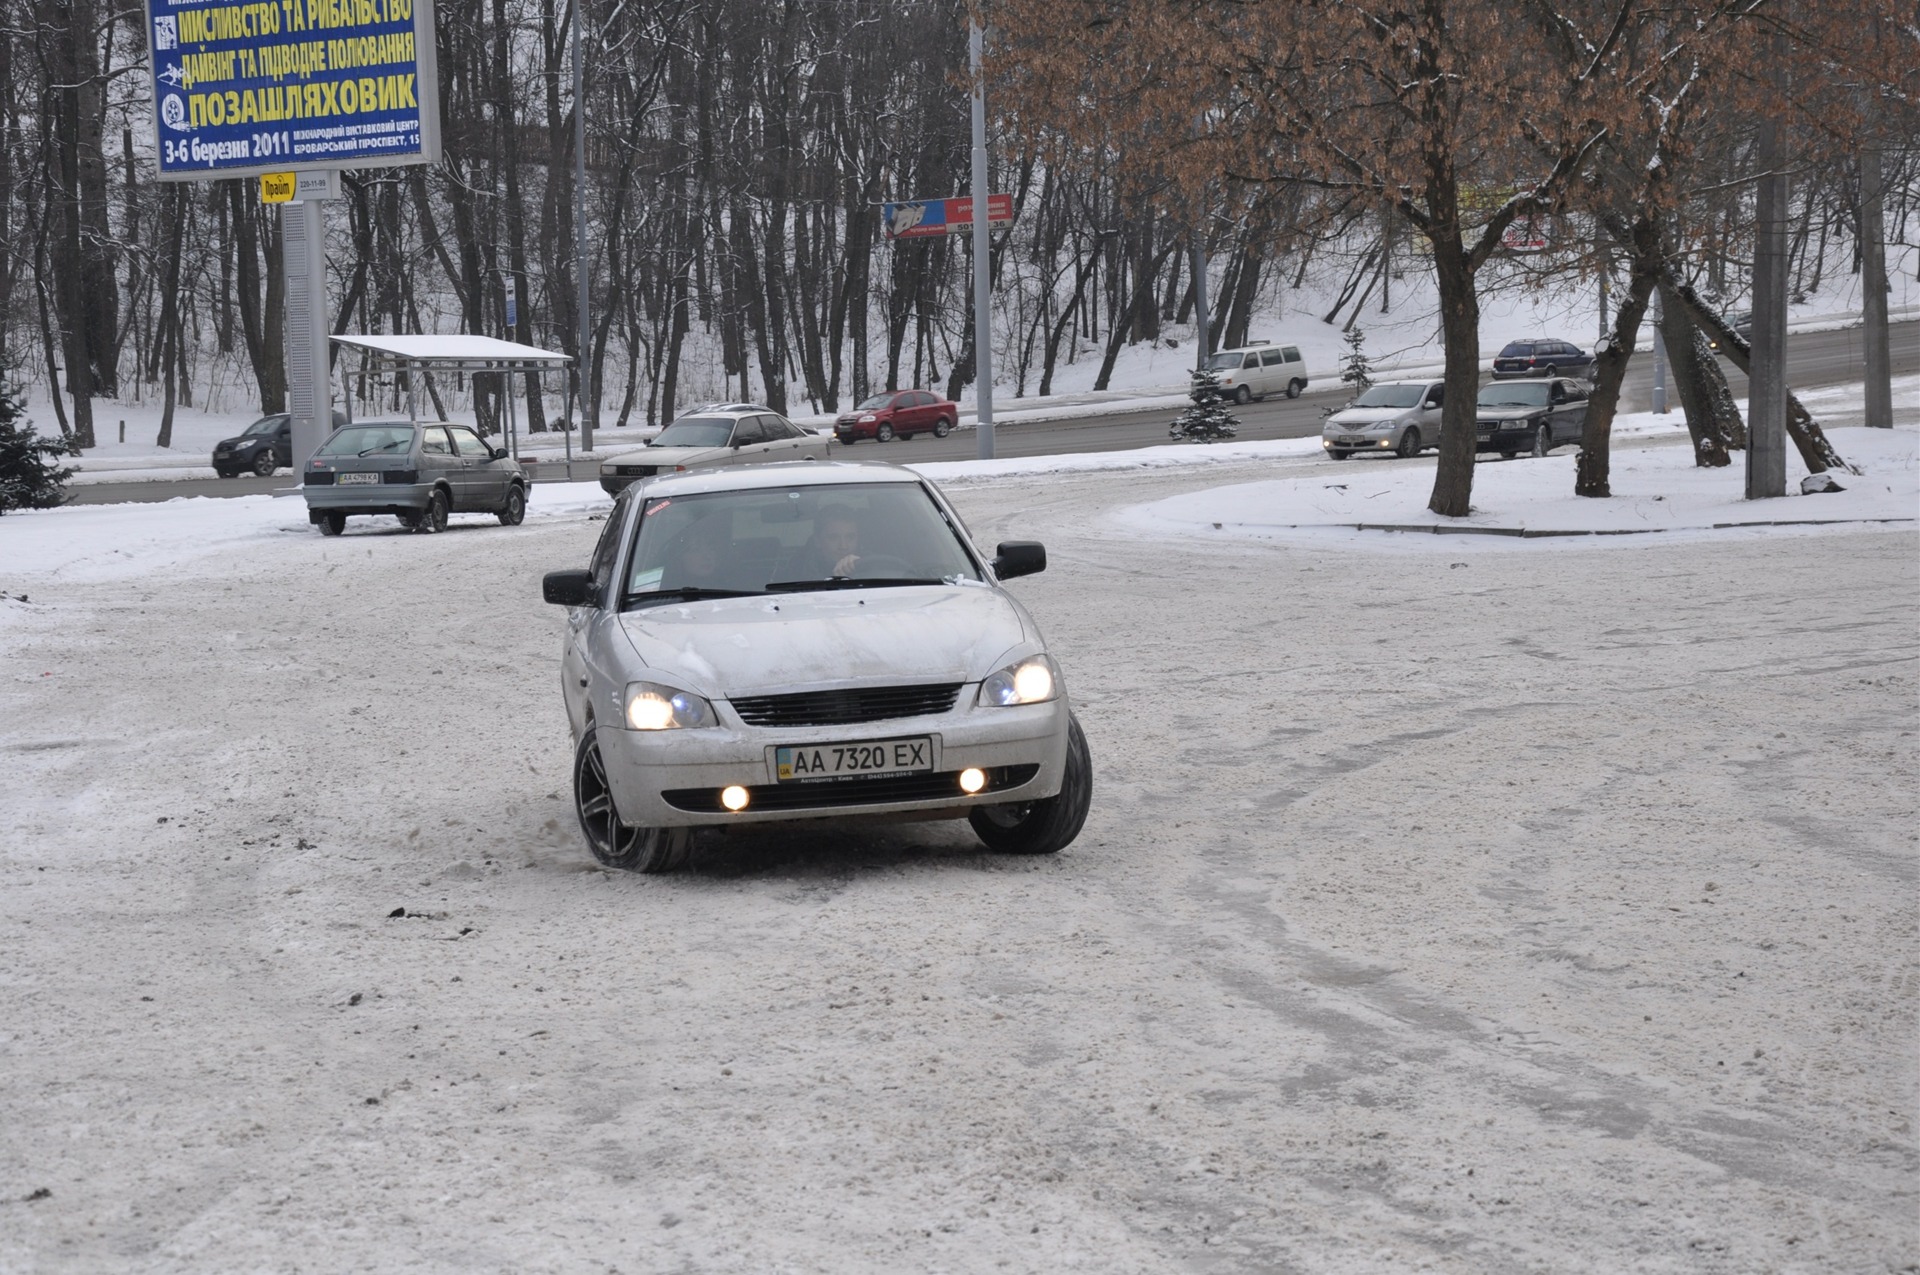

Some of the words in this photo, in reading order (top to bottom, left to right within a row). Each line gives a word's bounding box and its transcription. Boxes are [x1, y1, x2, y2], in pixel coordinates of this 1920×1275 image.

[178, 1, 280, 43] МИСЛИВСТВО
[282, 0, 306, 32] ТА
[307, 0, 412, 30] РИБАЛЬСТВО
[182, 44, 236, 90] ДАЙВІНГ
[238, 49, 258, 78] ТА
[259, 41, 327, 81] ПІДВОДНЕ
[328, 32, 415, 70] ПОЛЮВАННЯ
[189, 73, 417, 128] ПОЗАШЛЯХОВИК
[293, 125, 345, 140] МІЖНАРОДНИЙ
[346, 119, 395, 136] ВИСТАВКОВИЙ
[396, 120, 419, 133] ЦЕНТР
[294, 138, 357, 154] БРОВАРСЬКИЙ
[359, 135, 407, 150] ПРОСПЕКТ,
[409, 134, 420, 145] 15
[165, 139, 189, 163] 3-6
[191, 136, 250, 167] березня
[252, 131, 290, 157] 2011
[794, 750, 825, 773] AA
[832, 746, 885, 771] 7320
[894, 743, 924, 766] EX
